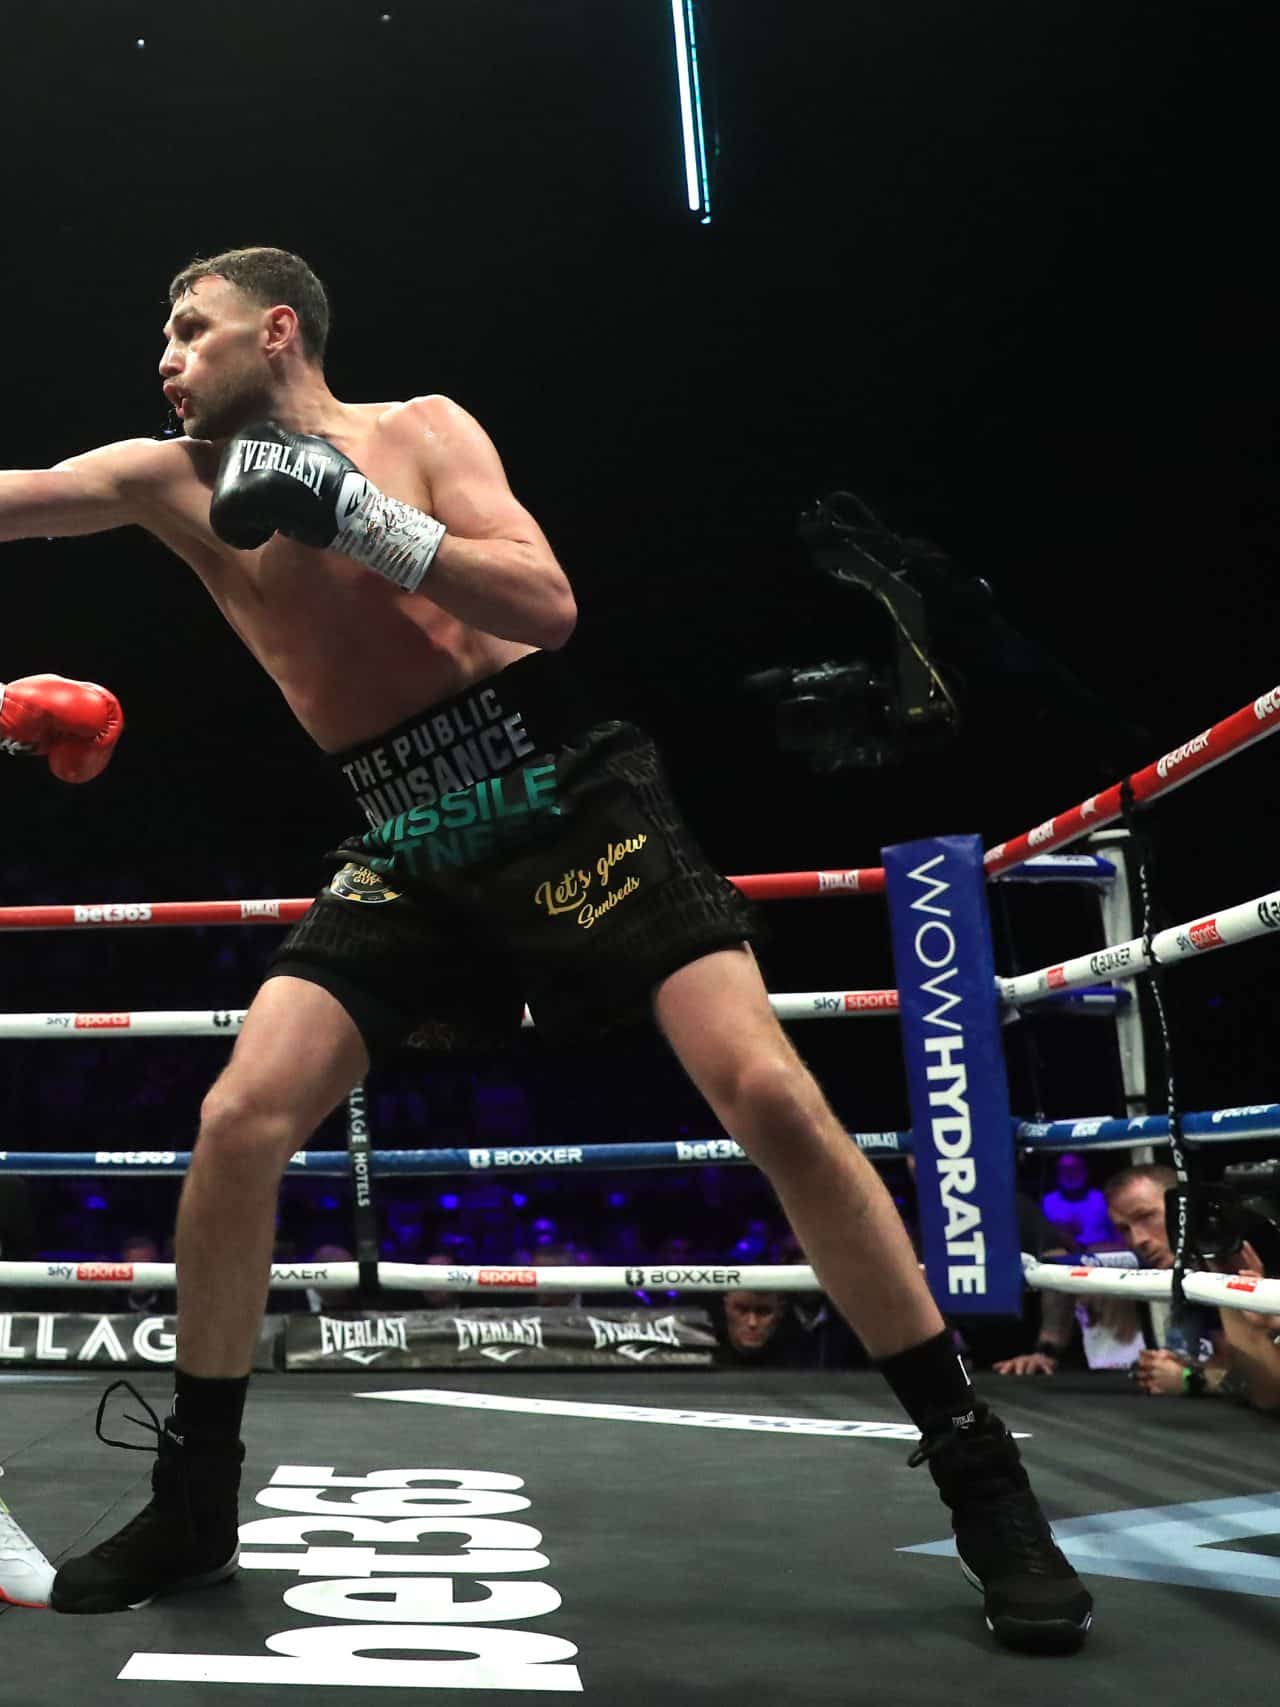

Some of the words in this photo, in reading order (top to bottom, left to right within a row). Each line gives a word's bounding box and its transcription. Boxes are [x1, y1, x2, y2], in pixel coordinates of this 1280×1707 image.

[234, 438, 333, 497] EVERLAST
[342, 747, 393, 793] THE
[392, 687, 503, 768] PUBLIC
[356, 711, 536, 831] NUISANCE
[535, 870, 593, 917] Let's
[595, 832, 648, 888] glow
[818, 869, 860, 892] EVERLAST
[73, 903, 153, 923] bet365
[576, 875, 641, 929] Sunbeds
[813, 996, 841, 1011] sky
[845, 990, 900, 1009] sports
[46, 1015, 71, 1029] sky
[75, 1013, 130, 1029] sports
[349, 1087, 369, 1144] LLAGE
[494, 1148, 583, 1166] BOXXER
[675, 1141, 746, 1161] bet36
[354, 1151, 371, 1207] HOTELS
[47, 1265, 73, 1280] sky
[77, 1263, 133, 1281] sports
[447, 1270, 472, 1285] sky
[479, 1269, 535, 1286] sports
[651, 1269, 741, 1284] BOXXER
[320, 1317, 409, 1352] EVERLAST
[454, 1316, 543, 1352] EVERLAST
[587, 1314, 680, 1347] EVERLAST
[116, 1465, 584, 1692] bet365
